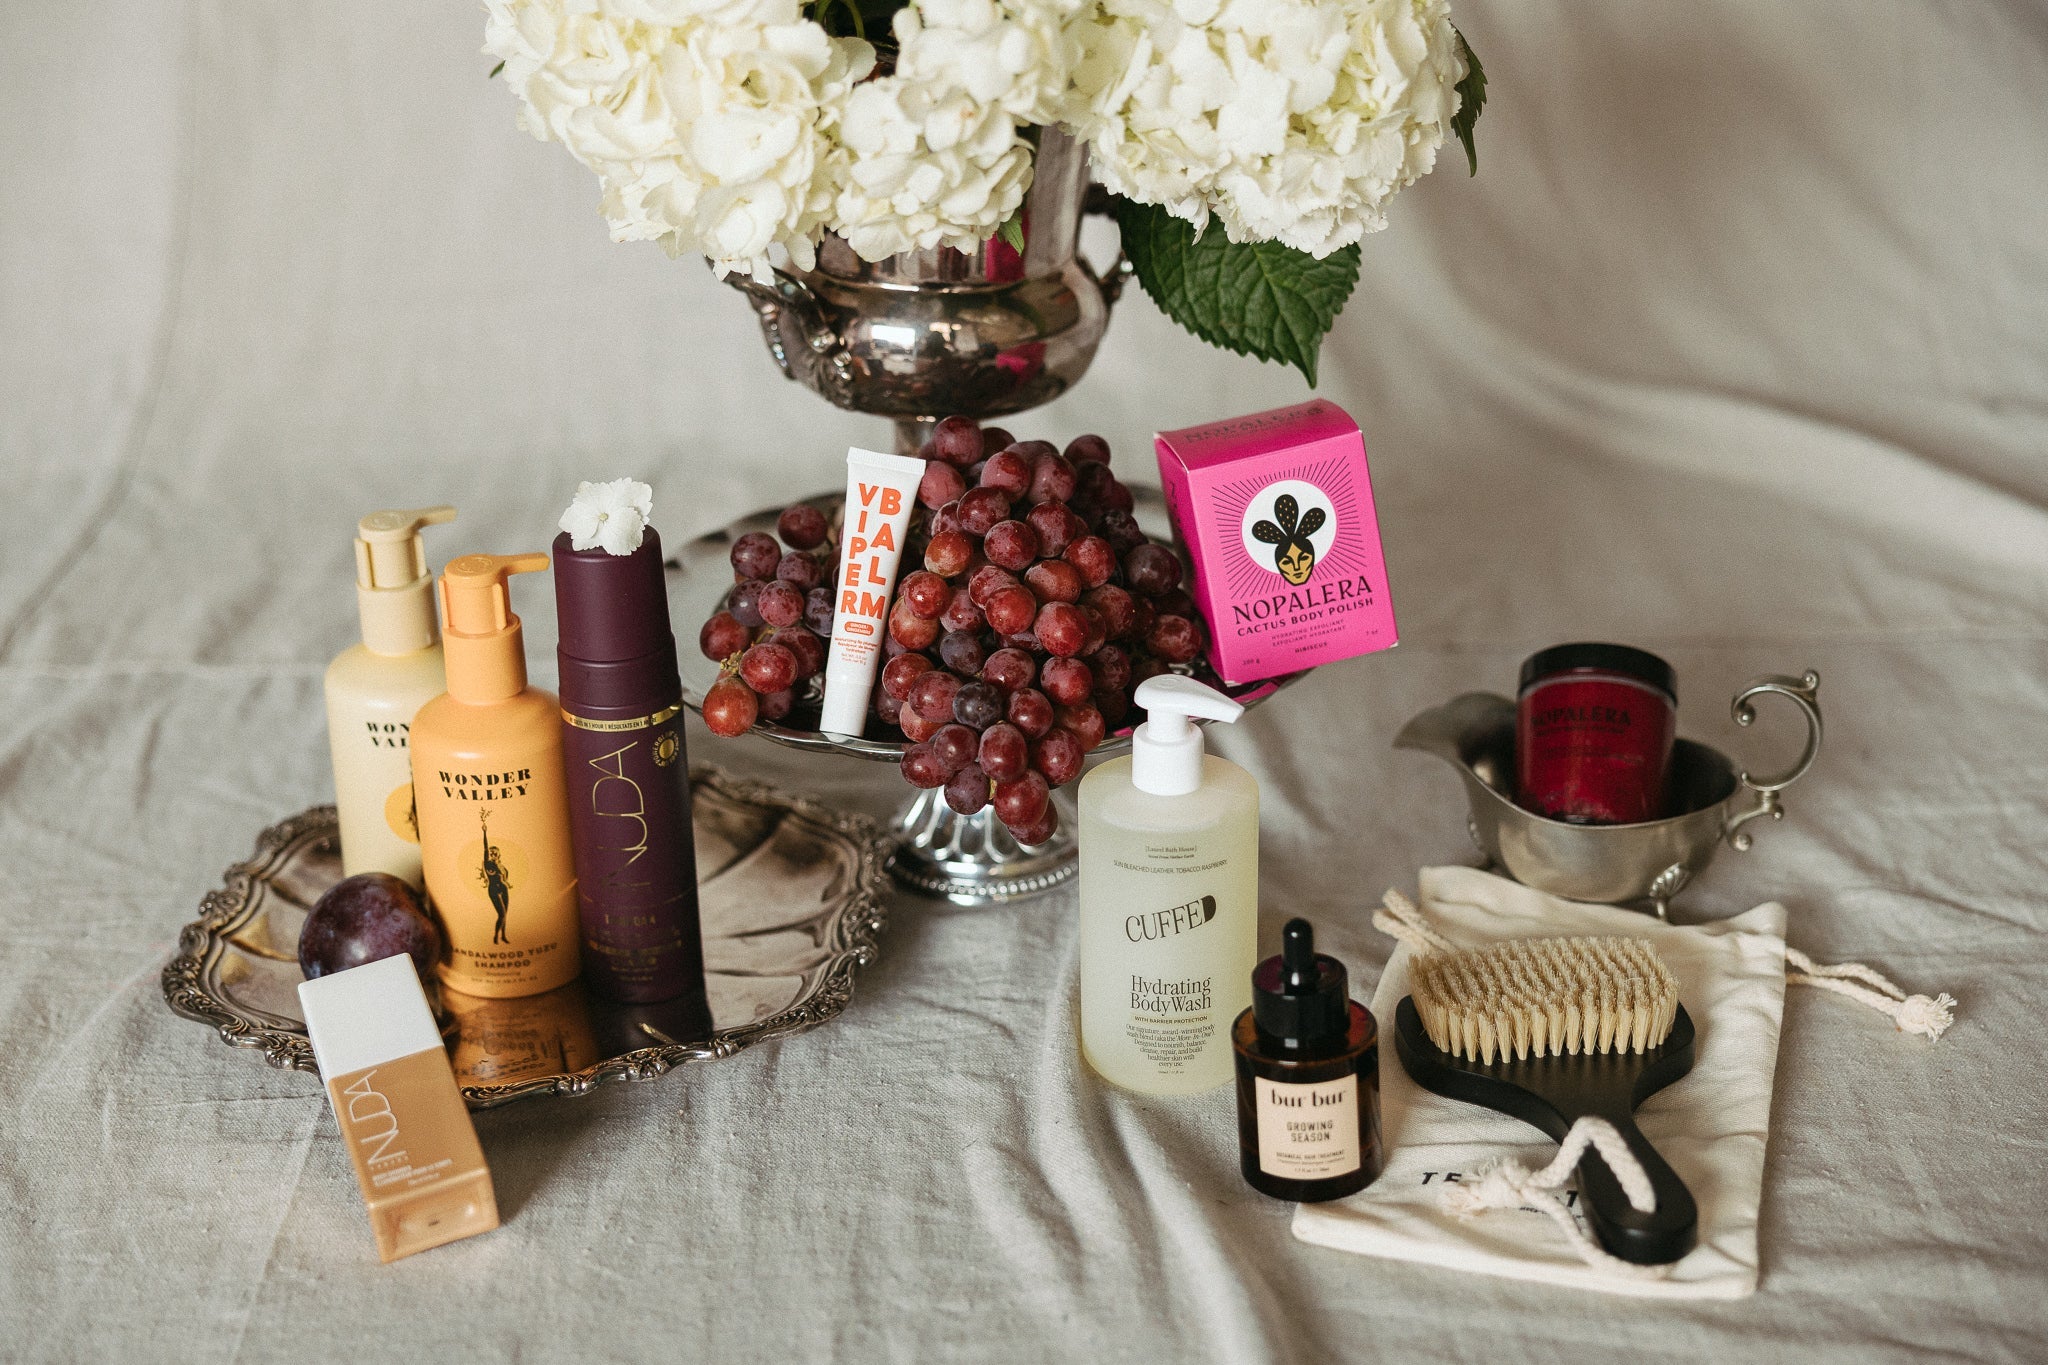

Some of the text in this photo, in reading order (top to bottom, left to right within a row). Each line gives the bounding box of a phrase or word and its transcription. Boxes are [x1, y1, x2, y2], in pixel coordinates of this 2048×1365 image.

[841, 483, 879, 615] VIPER
[859, 487, 902, 620] BALM
[1232, 576, 1373, 625] NOPALERA
[1237, 597, 1374, 637] CACTUS BODY POLISH
[1271, 619, 1345, 641] HYDRATING EXFOLIANT
[1272, 625, 1346, 647] EXFOLIANT HYDRATANT
[1294, 642, 1328, 654] HIBISCUS
[366, 721, 411, 733] WON
[371, 736, 410, 748] VAL
[439, 768, 532, 787] WONDER
[443, 783, 529, 801] VALLEY
[1125, 894, 1217, 943] CUFFED
[453, 948, 524, 959] ANDALWOOD
[1131, 974, 1212, 996] Hydrating
[1134, 1015, 1208, 1025] WITH BARRIER PROTECTION
[1271, 1088, 1346, 1108] bur bur
[343, 1068, 408, 1165] NUDA
[1286, 1119, 1334, 1131] GROWING
[1290, 1131, 1331, 1143] SEASON
